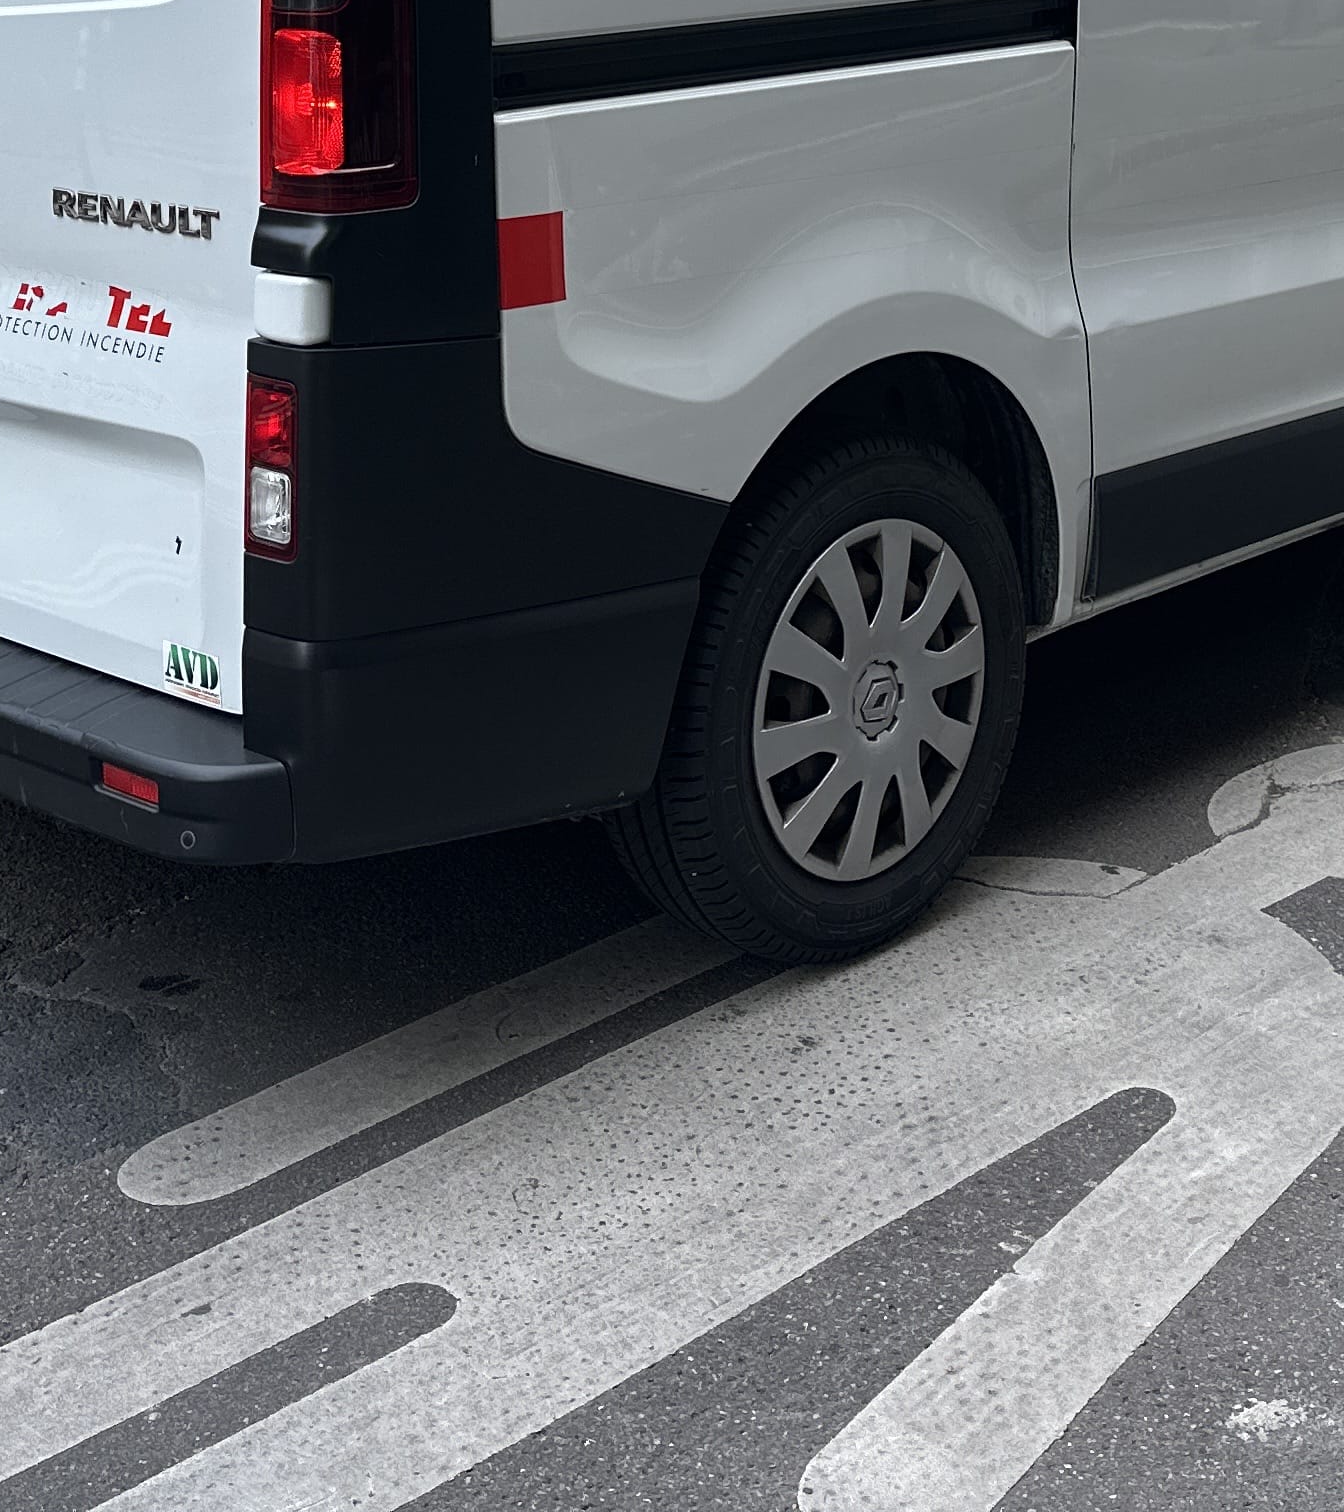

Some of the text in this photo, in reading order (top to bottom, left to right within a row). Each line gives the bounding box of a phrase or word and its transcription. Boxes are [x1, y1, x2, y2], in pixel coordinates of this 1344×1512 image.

[52, 186, 220, 240] RENAULT
[80, 330, 165, 364] INCENDIE
[164, 643, 219, 691] AVD
